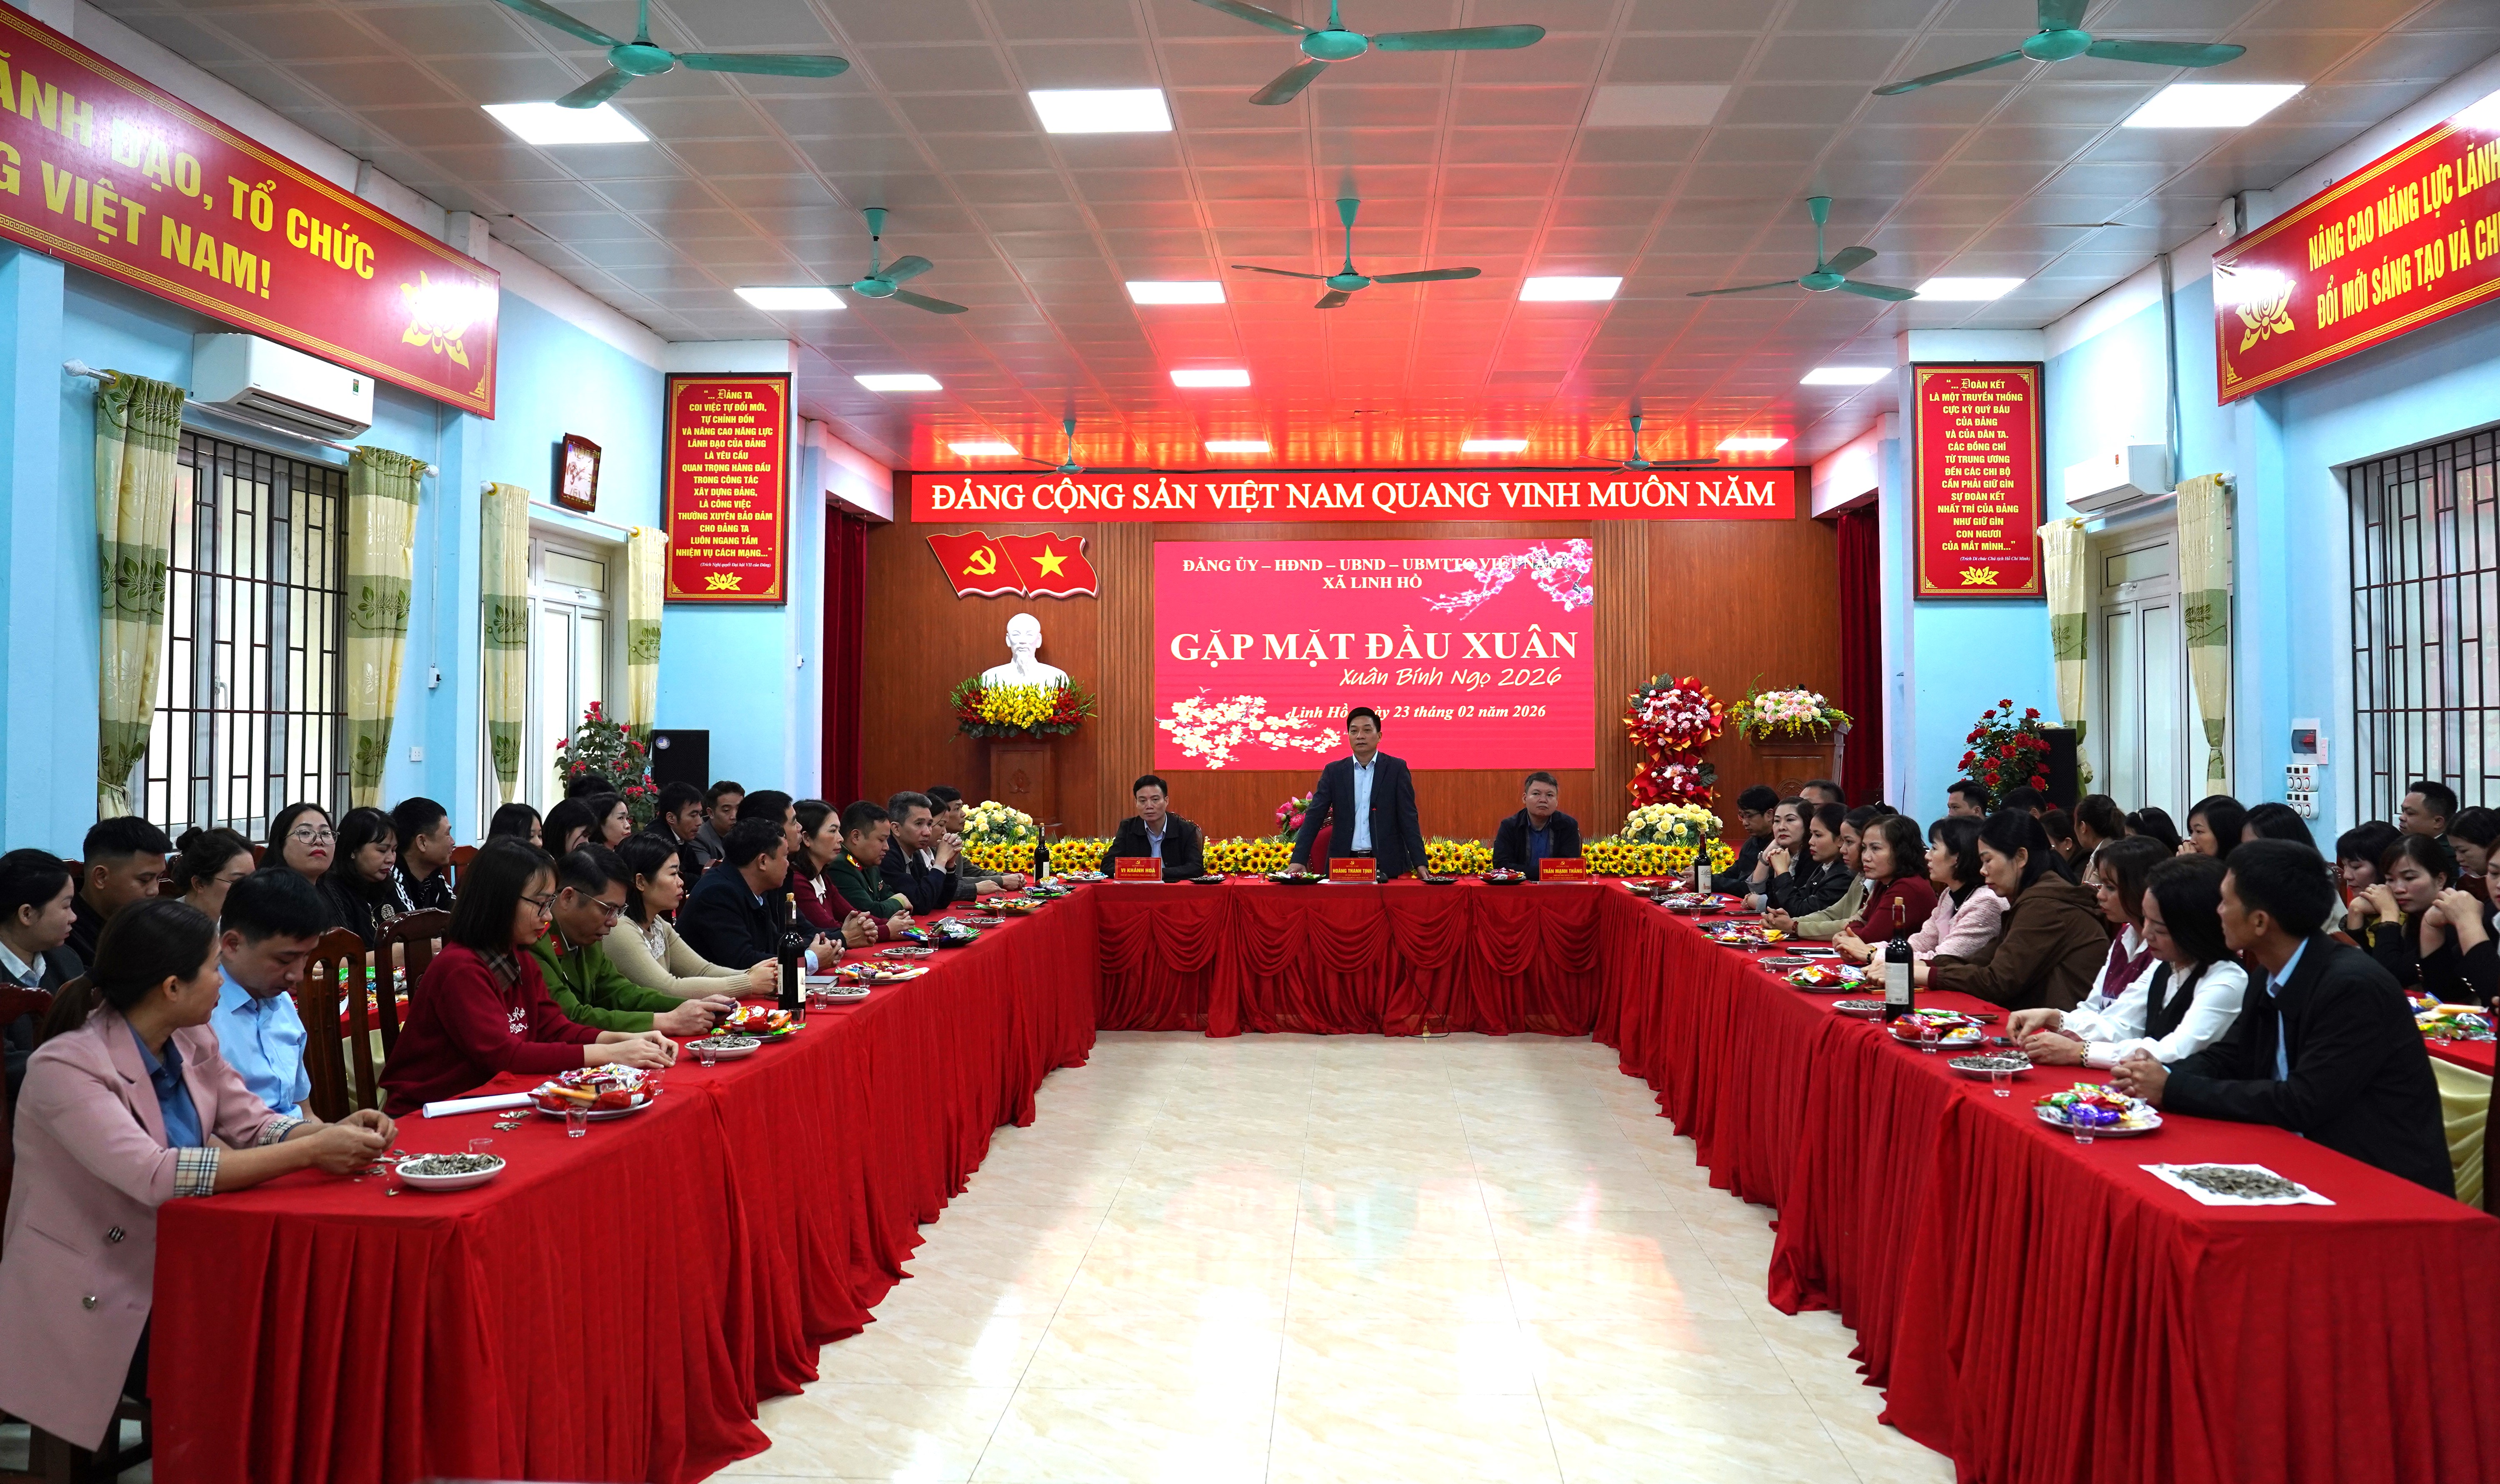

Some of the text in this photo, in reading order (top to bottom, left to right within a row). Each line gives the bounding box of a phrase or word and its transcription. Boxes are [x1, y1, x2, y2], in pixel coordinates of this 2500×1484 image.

[110, 117, 212, 210] ĐẠO,
[228, 175, 276, 232] TỔ
[287, 208, 374, 279] CHỨC
[2309, 137, 2500, 272] NÂNG CAO NĂNG LỰC LÃNH
[41, 160, 146, 245] VIỆT
[161, 215, 270, 300] NAM!
[2318, 211, 2500, 329] ĐỔI MỚI SÁNG TẠO VÀ CH
[1960, 379, 2005, 392] ĐOÀN KẾT
[718, 389, 742, 402] ĐẢNG
[1930, 391, 2022, 402] LÀ MỘT TRUYỀN THỐNG
[704, 402, 721, 412] VIỆC
[723, 403, 733, 412] TỰ
[734, 401, 747, 411] ĐỔI
[750, 402, 767, 412] MỚI,
[1943, 405, 2010, 415] CỰC KỲ QUÝ BÁU
[701, 413, 754, 425] TỰ CHỈNH ĐỐN
[1956, 416, 1998, 426] CỦA ĐẢNG
[682, 427, 692, 435] VÀ
[694, 427, 715, 435] NÂNG
[735, 427, 756, 435] NĂNG
[758, 428, 772, 437] LỰC
[1945, 430, 1956, 438] VÀ
[1959, 428, 1975, 438] CỦA
[1978, 430, 1995, 438] DÂN
[688, 438, 766, 449] LÃNH ĐẠO CỦA ĐẢNG
[1948, 441, 2006, 451] CÁC ĐỒNG CHÍ
[705, 450, 748, 459] LÀ YÊU CẦU
[1945, 454, 1956, 463] TỪ
[705, 465, 729, 473] TRỌNG
[732, 463, 752, 472] HÀNG
[755, 462, 770, 472] ĐẦU
[1945, 466, 1962, 475] ĐẾN
[1964, 467, 1980, 475] CÁC
[2000, 467, 2010, 477] BỘ
[721, 475, 742, 483] CÔNG
[744, 475, 758, 484] TÁC
[1942, 478, 2014, 488] CẦN PHẢI GIỮ GÌN
[694, 486, 757, 497] XÂY DỰNG ĐẢNG,
[932, 475, 1775, 513] ĐẢNG CỘNG SẢN VIỆT NAM QUANG VINH MUÔN NĂM
[1951, 490, 2005, 502] SỰ ĐOÀN KẾT
[700, 499, 751, 509] LÀ CÔNG VIỆC
[1938, 503, 2018, 513] NHẤT TRÍ CỦA ĐẢNG
[678, 510, 772, 520] THƯỜNG XUYÊN BẢO ĐẢM
[1973, 517, 1988, 525] GIỮ
[1990, 516, 2003, 525] GÌN
[717, 522, 738, 532] ĐẢNG
[691, 535, 710, 544] LUÔN
[741, 535, 758, 544] TẦM
[1942, 540, 1959, 550] CỦA
[1961, 540, 1979, 550] MẮT
[676, 547, 700, 557] NHIỆM
[703, 549, 712, 558] VỤ
[715, 548, 735, 556] CÁCH
[1183, 557, 1231, 571] ĐẢNG
[1235, 557, 1259, 571] ỦY
[1275, 560, 1322, 571] HĐND
[1339, 559, 1386, 571] UBND
[1402, 558, 1476, 572] UBMTTQ
[1524, 558, 1562, 570] NAM
[1322, 573, 1422, 588] XÃ LINH HỒ
[1170, 624, 1578, 667] GẶP MẶT ĐẦU XUÂN
[1340, 667, 1562, 691] Xuân Bính Ngọ 2026
[1290, 706, 1323, 718] Linh
[1327, 703, 1348, 718] Hồ
[1393, 706, 1410, 717] 23
[1414, 706, 1454, 720] tháng
[1458, 706, 1475, 717] 02
[1478, 706, 1509, 717] năm
[1512, 705, 1546, 717] 2026
